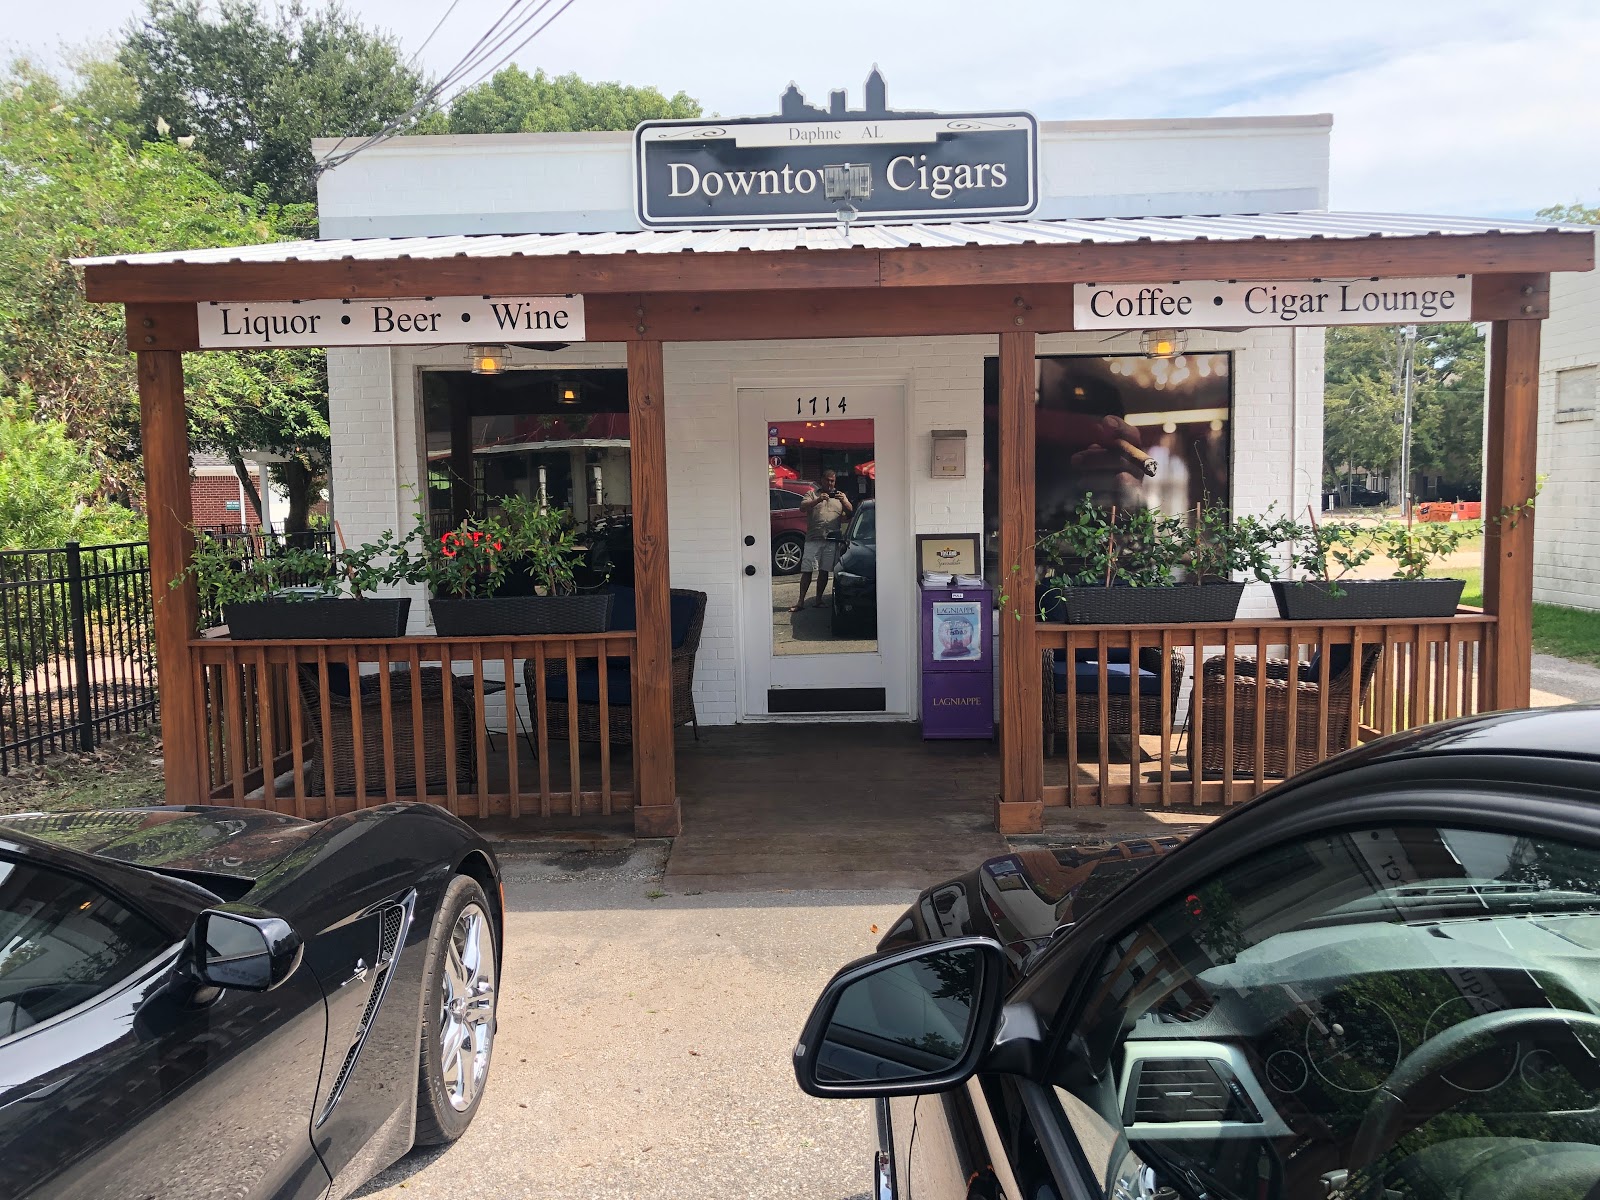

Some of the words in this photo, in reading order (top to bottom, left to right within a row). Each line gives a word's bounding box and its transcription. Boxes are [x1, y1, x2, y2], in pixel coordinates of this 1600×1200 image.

[788, 126, 842, 144] Daphne
[862, 125, 884, 139] AL
[667, 161, 872, 198] Downto
[886, 154, 1008, 200] Cigars
[1090, 288, 1193, 318] Coffee
[1244, 285, 1329, 321] Cigar
[1338, 283, 1456, 318] Lounge
[219, 307, 321, 343] Liquor
[371, 306, 442, 333] Beer
[490, 302, 570, 330] Wine
[797, 396, 847, 415] 1714
[936, 606, 975, 614] LAGNIAPPE
[933, 697, 982, 706] LAGNIAPPE
